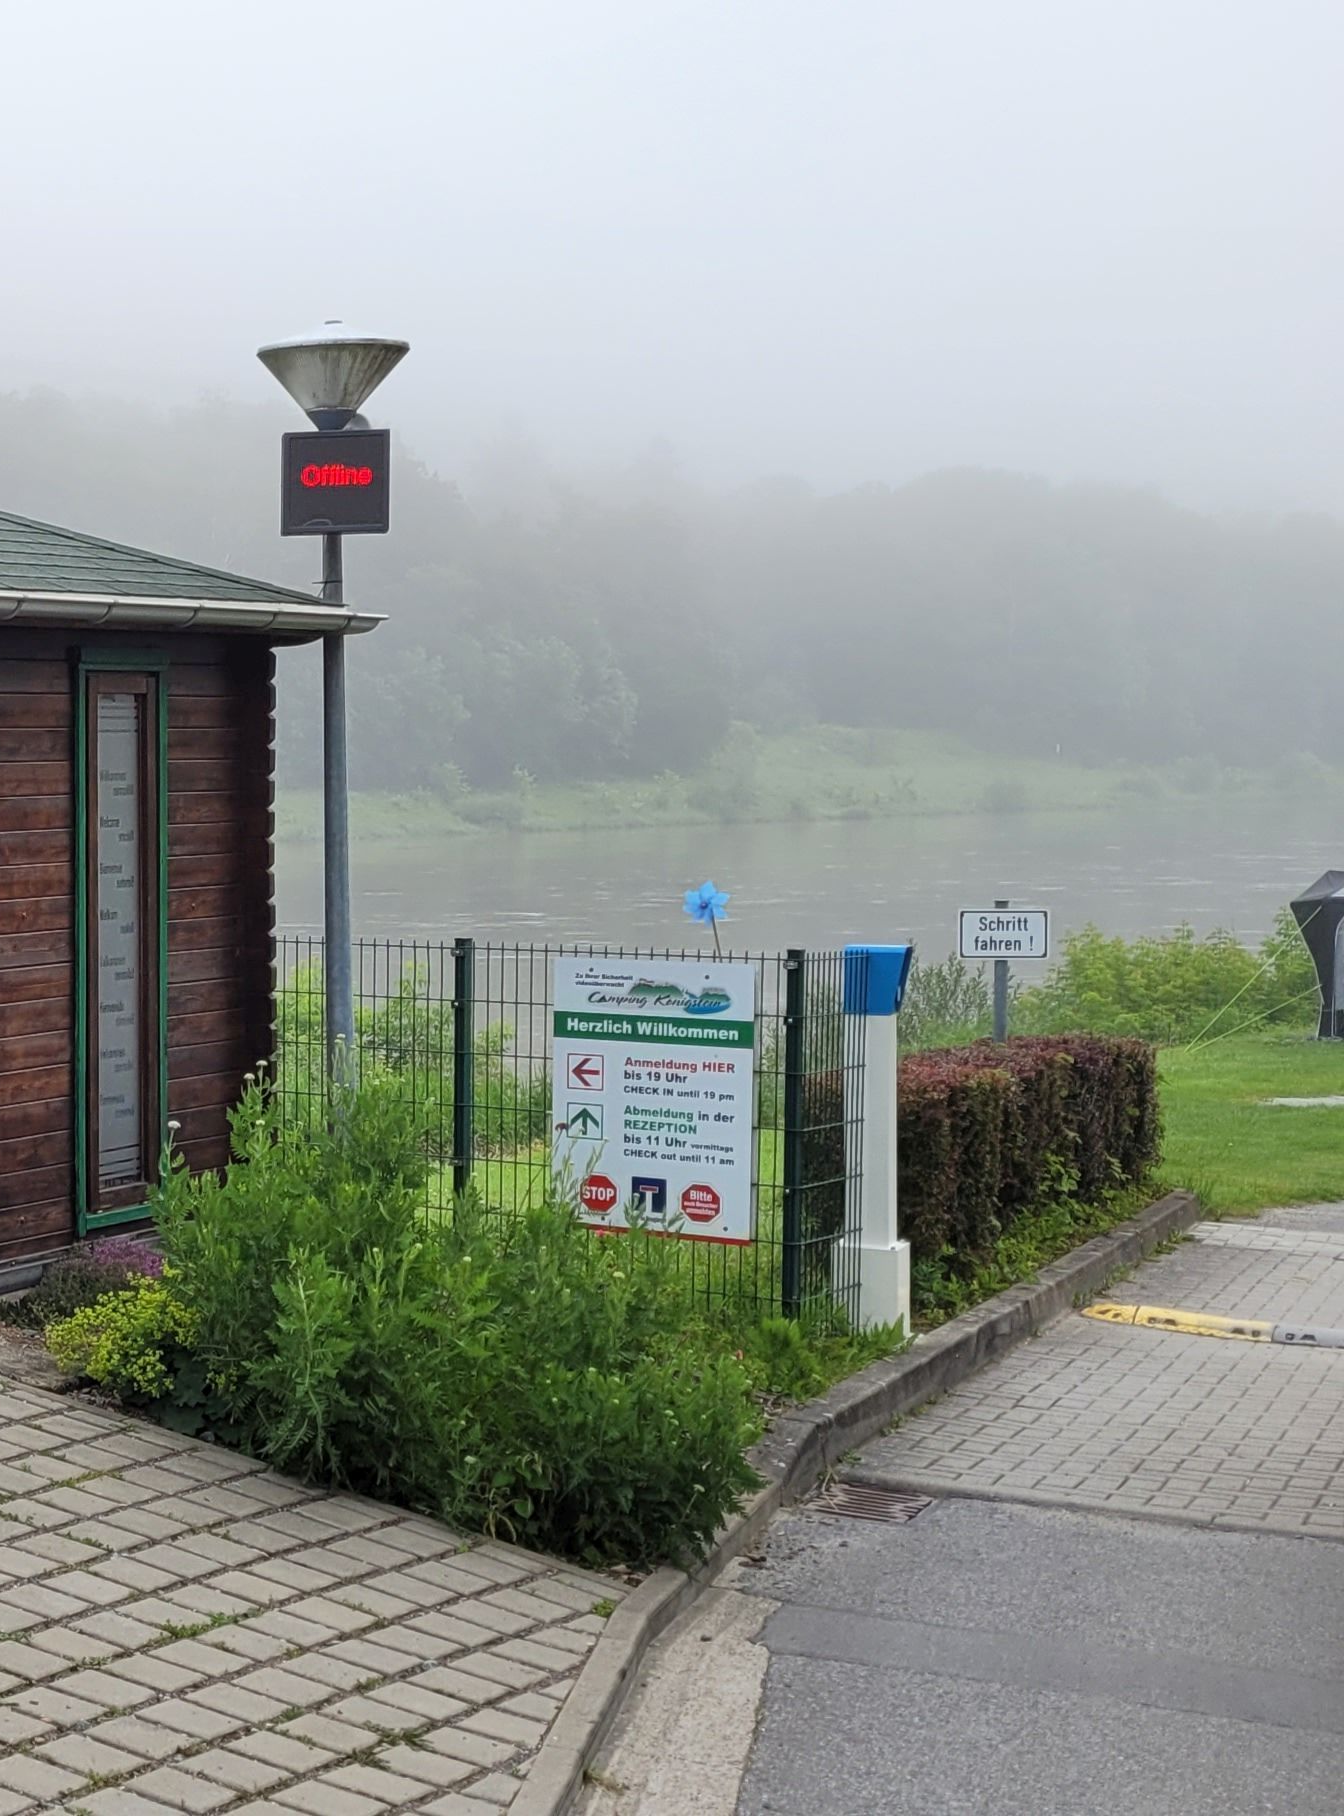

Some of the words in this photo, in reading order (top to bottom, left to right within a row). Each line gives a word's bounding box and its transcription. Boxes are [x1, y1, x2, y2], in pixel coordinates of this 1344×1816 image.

[301, 463, 373, 488] Offline
[978, 915, 1029, 932] Schritt
[974, 935, 1022, 952] fahren
[1029, 935, 1034, 952] !
[588, 991, 648, 1009] Camping
[566, 1017, 632, 1035] Herzlich
[637, 1021, 740, 1041] Willkommen
[624, 1056, 698, 1073] Anmeldung
[702, 1061, 736, 1074] HIER
[624, 1070, 642, 1081] bis
[646, 1071, 661, 1082] 19
[665, 1071, 688, 1084] Uhr
[624, 1085, 660, 1096] CHECK
[663, 1087, 674, 1097] IN
[677, 1088, 700, 1099] until
[703, 1090, 716, 1099] 19
[719, 1093, 735, 1102] pm
[624, 1105, 694, 1123] Abmeldung
[698, 1110, 711, 1122] in
[713, 1111, 735, 1124] der
[624, 1119, 698, 1135] REZEPTION
[624, 1134, 642, 1146] bis
[646, 1135, 660, 1146] 11
[665, 1136, 688, 1149] Uhr
[691, 1143, 734, 1153] vormittags
[624, 1149, 658, 1160] CHECK
[661, 1152, 677, 1161] out
[680, 1152, 702, 1163] until
[705, 1155, 716, 1164] 11
[719, 1157, 735, 1166] am
[582, 1186, 615, 1202] STOP
[689, 1190, 713, 1202] Bitte
